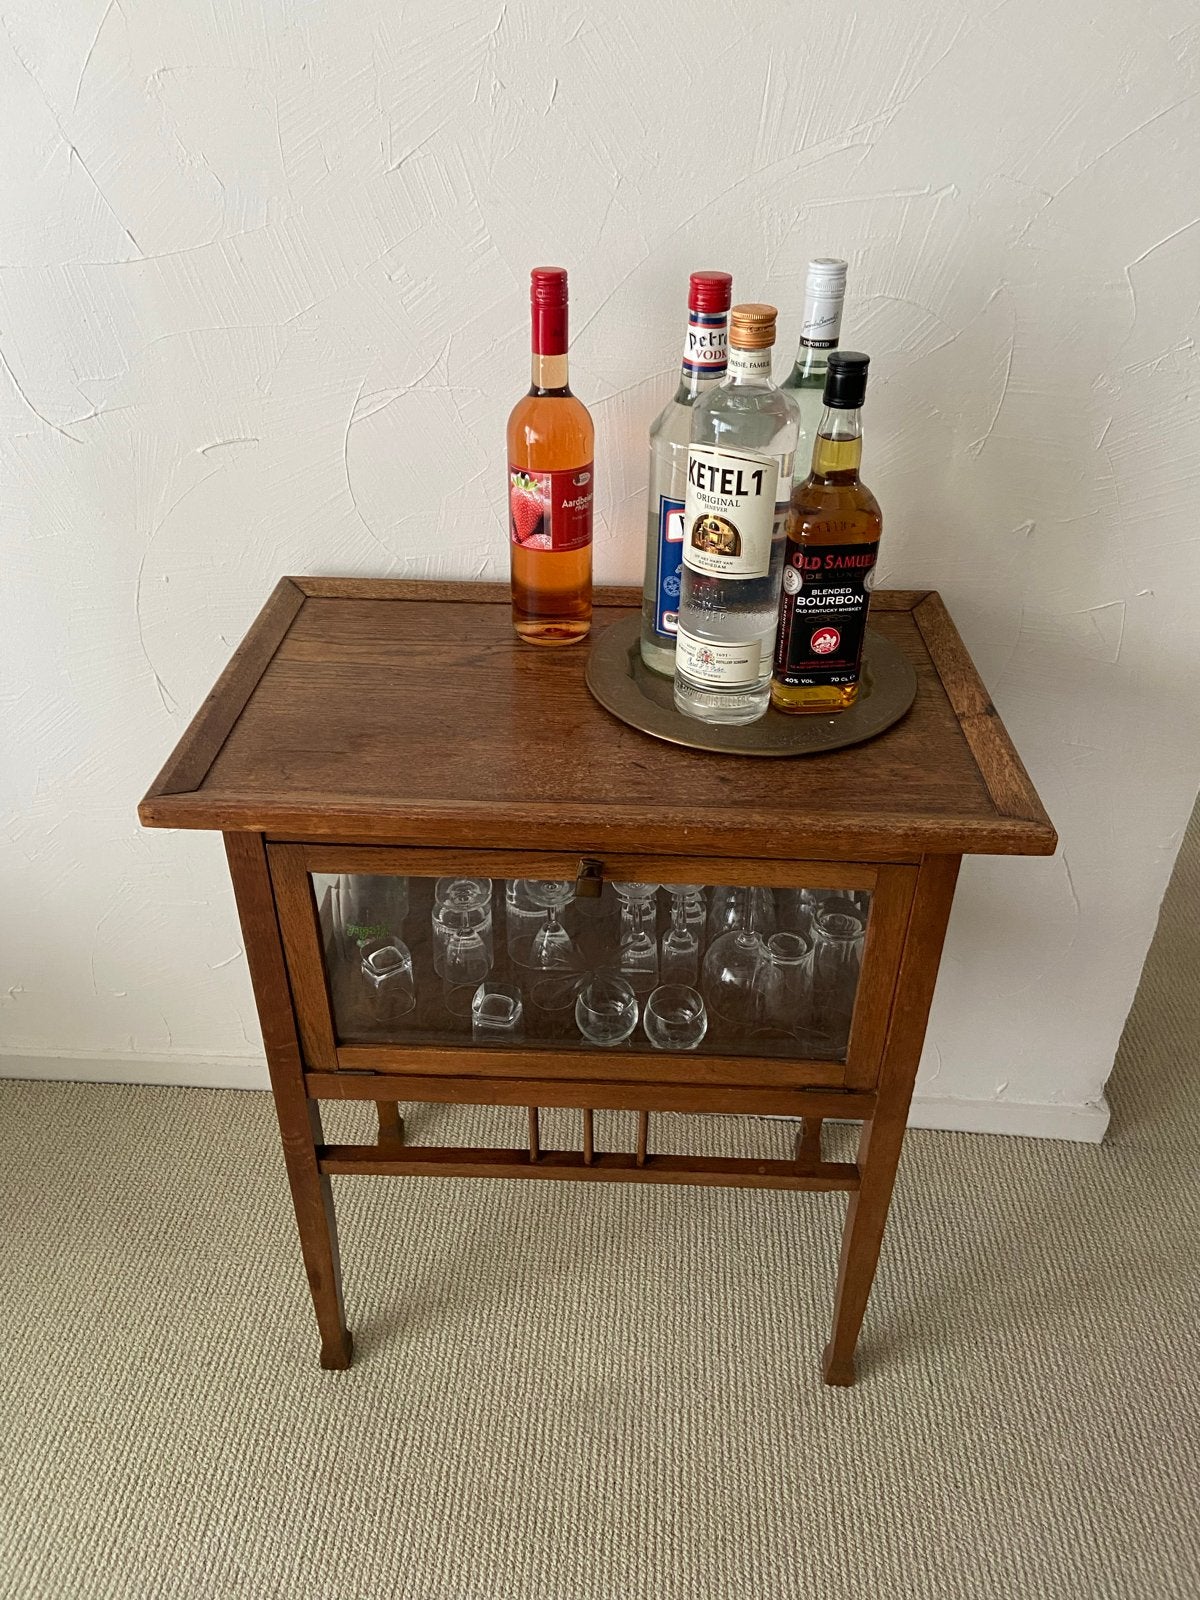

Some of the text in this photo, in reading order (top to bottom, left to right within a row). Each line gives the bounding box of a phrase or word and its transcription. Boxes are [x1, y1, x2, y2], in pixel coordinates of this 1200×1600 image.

[696, 349, 727, 360] VODK
[688, 456, 763, 496] KETEL 1
[696, 492, 741, 508] ORIGINAL
[704, 503, 728, 513] JENEVER
[792, 551, 821, 571] OLD
[811, 587, 852, 596] BLENDED
[796, 594, 864, 606] BOURBON
